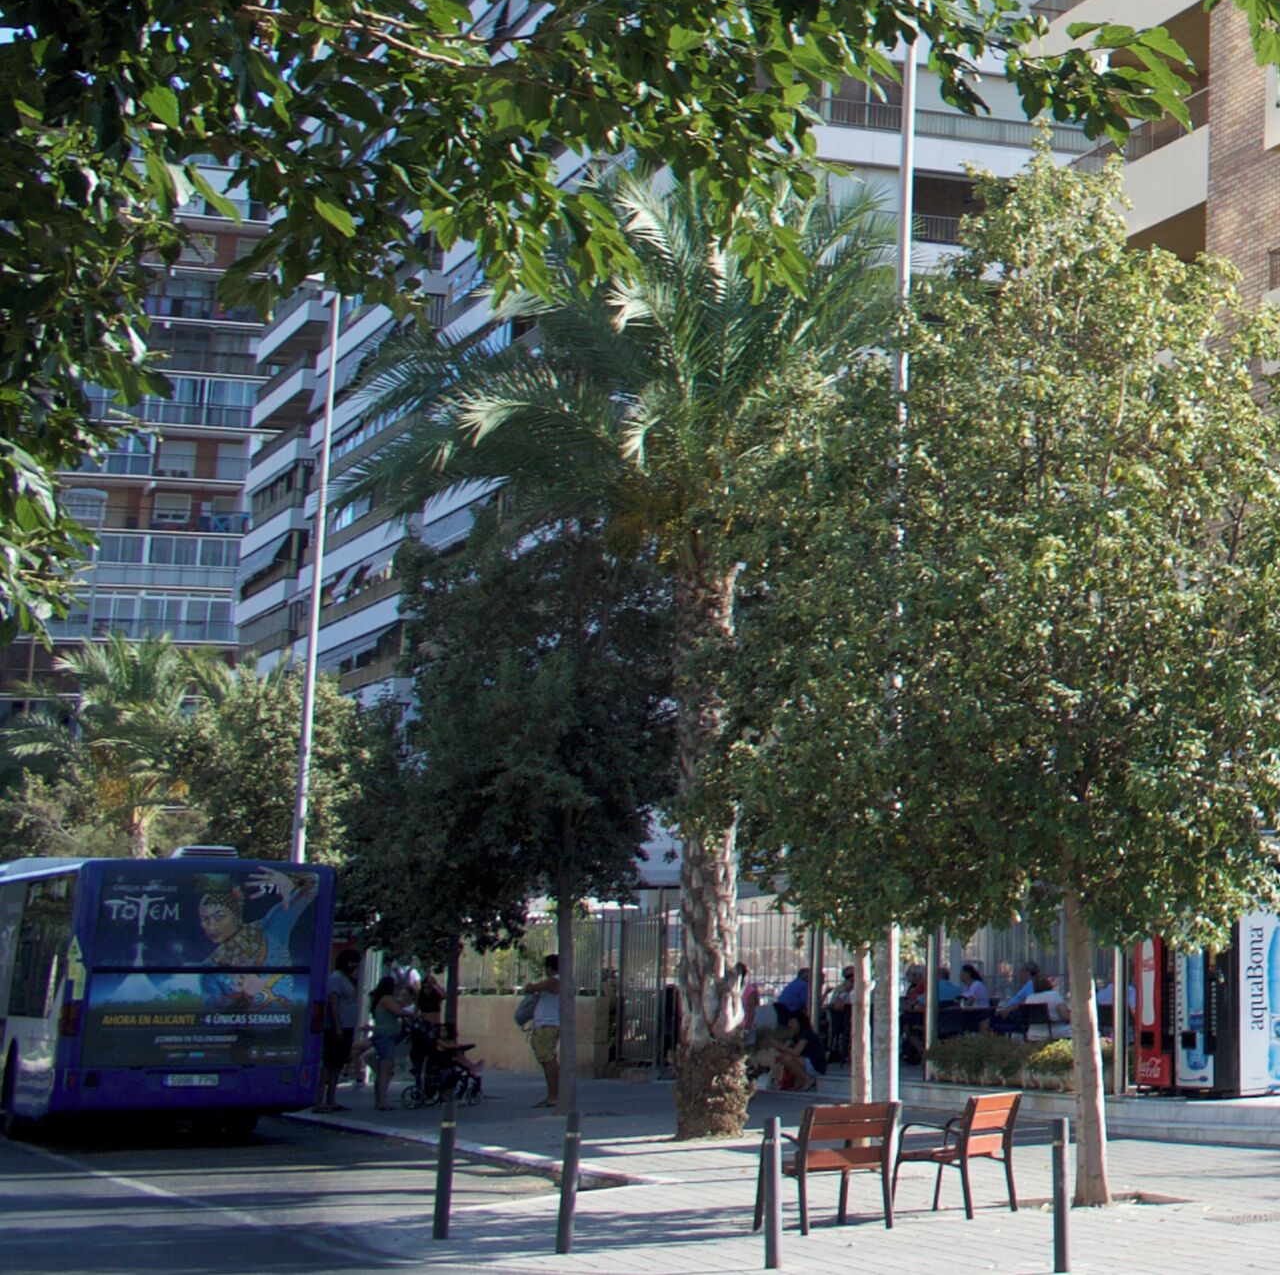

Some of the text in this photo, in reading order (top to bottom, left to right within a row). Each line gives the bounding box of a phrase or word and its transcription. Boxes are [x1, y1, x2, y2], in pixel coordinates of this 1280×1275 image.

[103, 894, 181, 929] TOTEM
[1246, 926, 1267, 1031] aquaBona
[101, 1012, 292, 1025] AHORA EN ALICANTE 4 ÚNICAS SEMANAS
